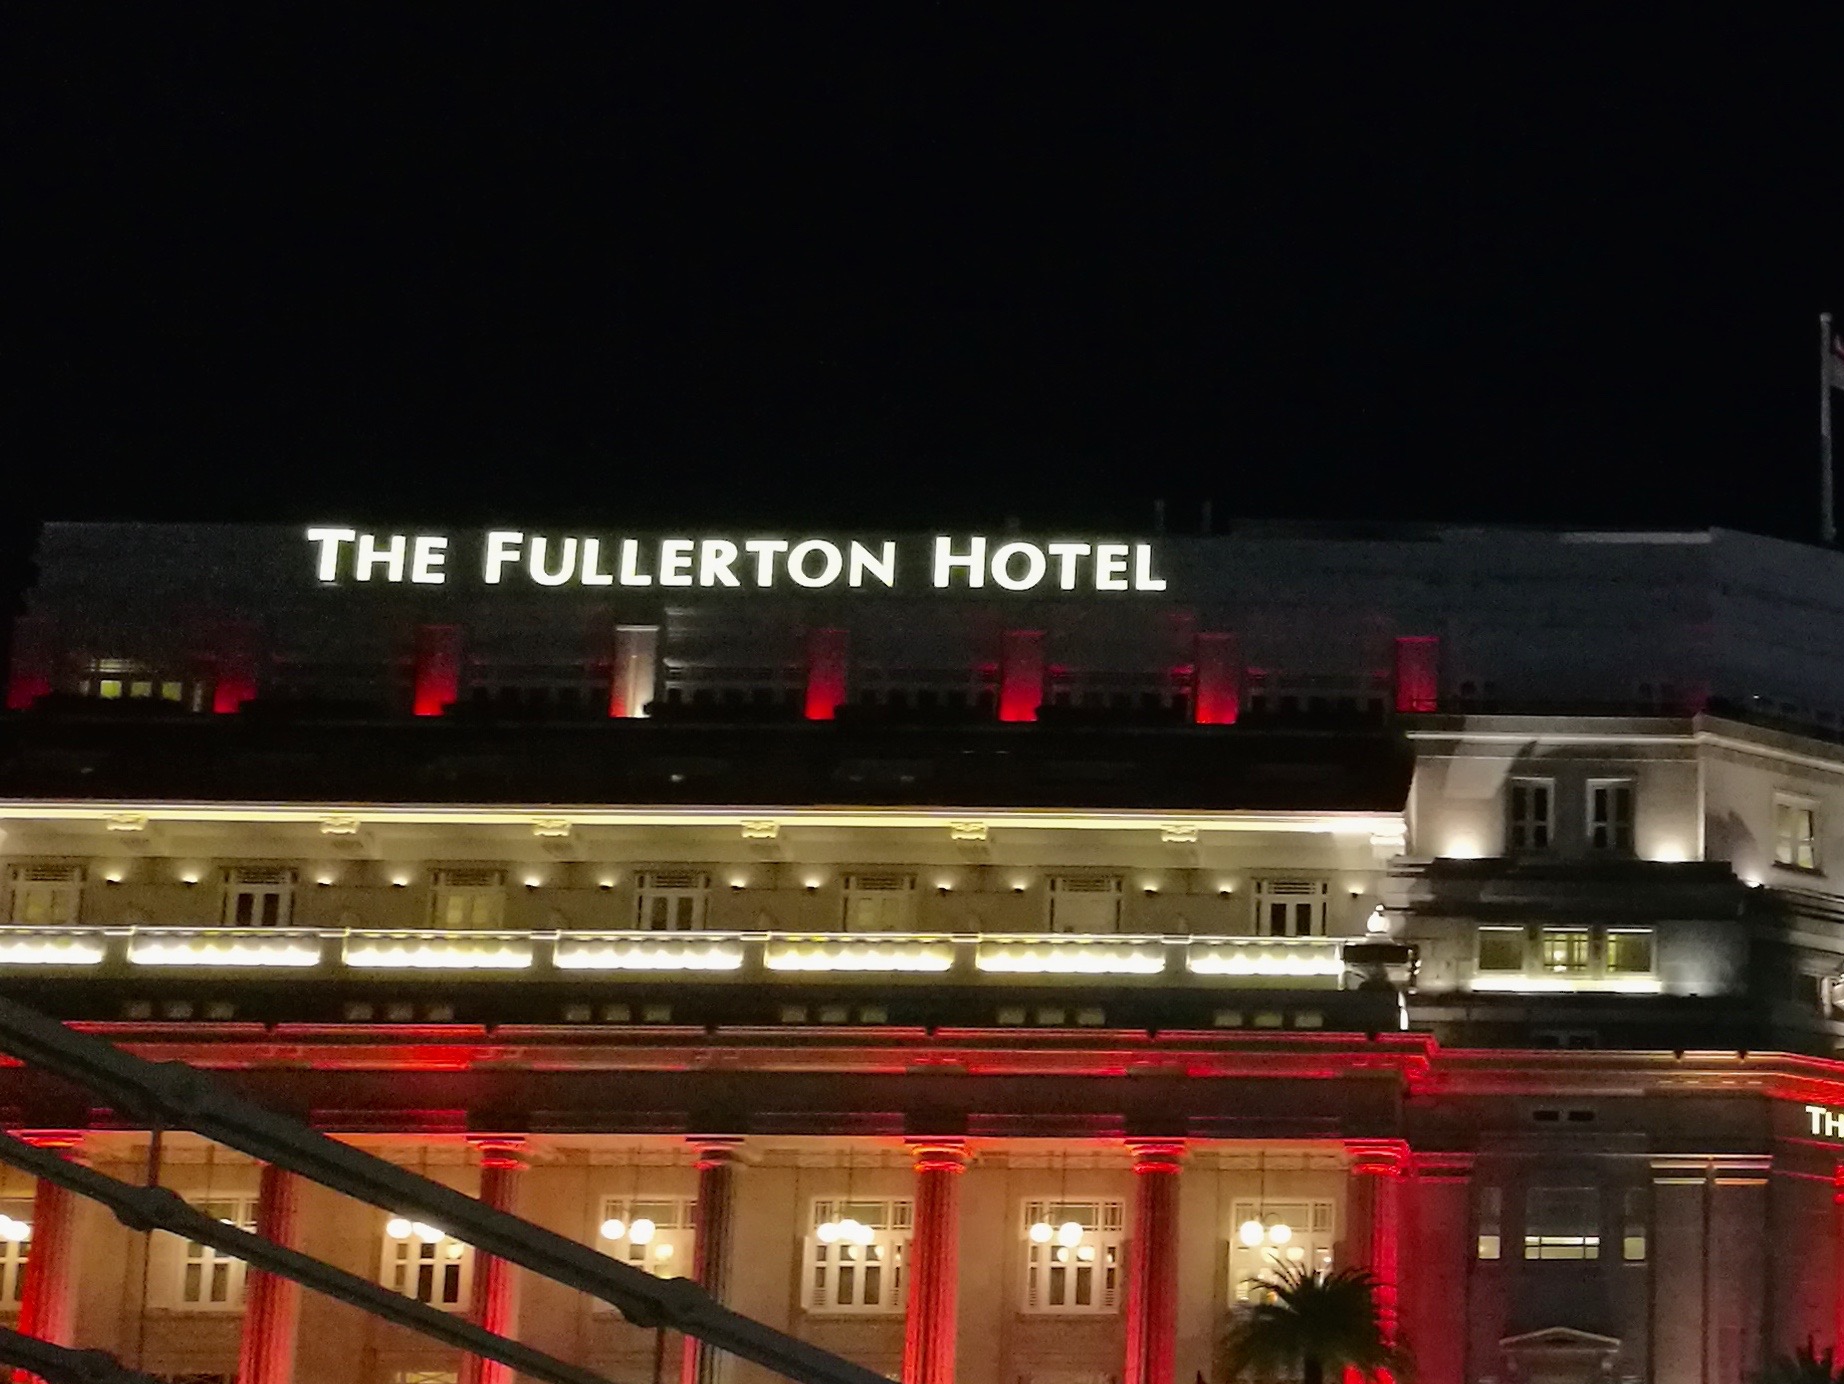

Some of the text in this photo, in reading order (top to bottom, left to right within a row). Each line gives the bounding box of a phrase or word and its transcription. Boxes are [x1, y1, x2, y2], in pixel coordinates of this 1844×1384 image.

[306, 528, 1168, 592] THE FULLERTON HOTEL
